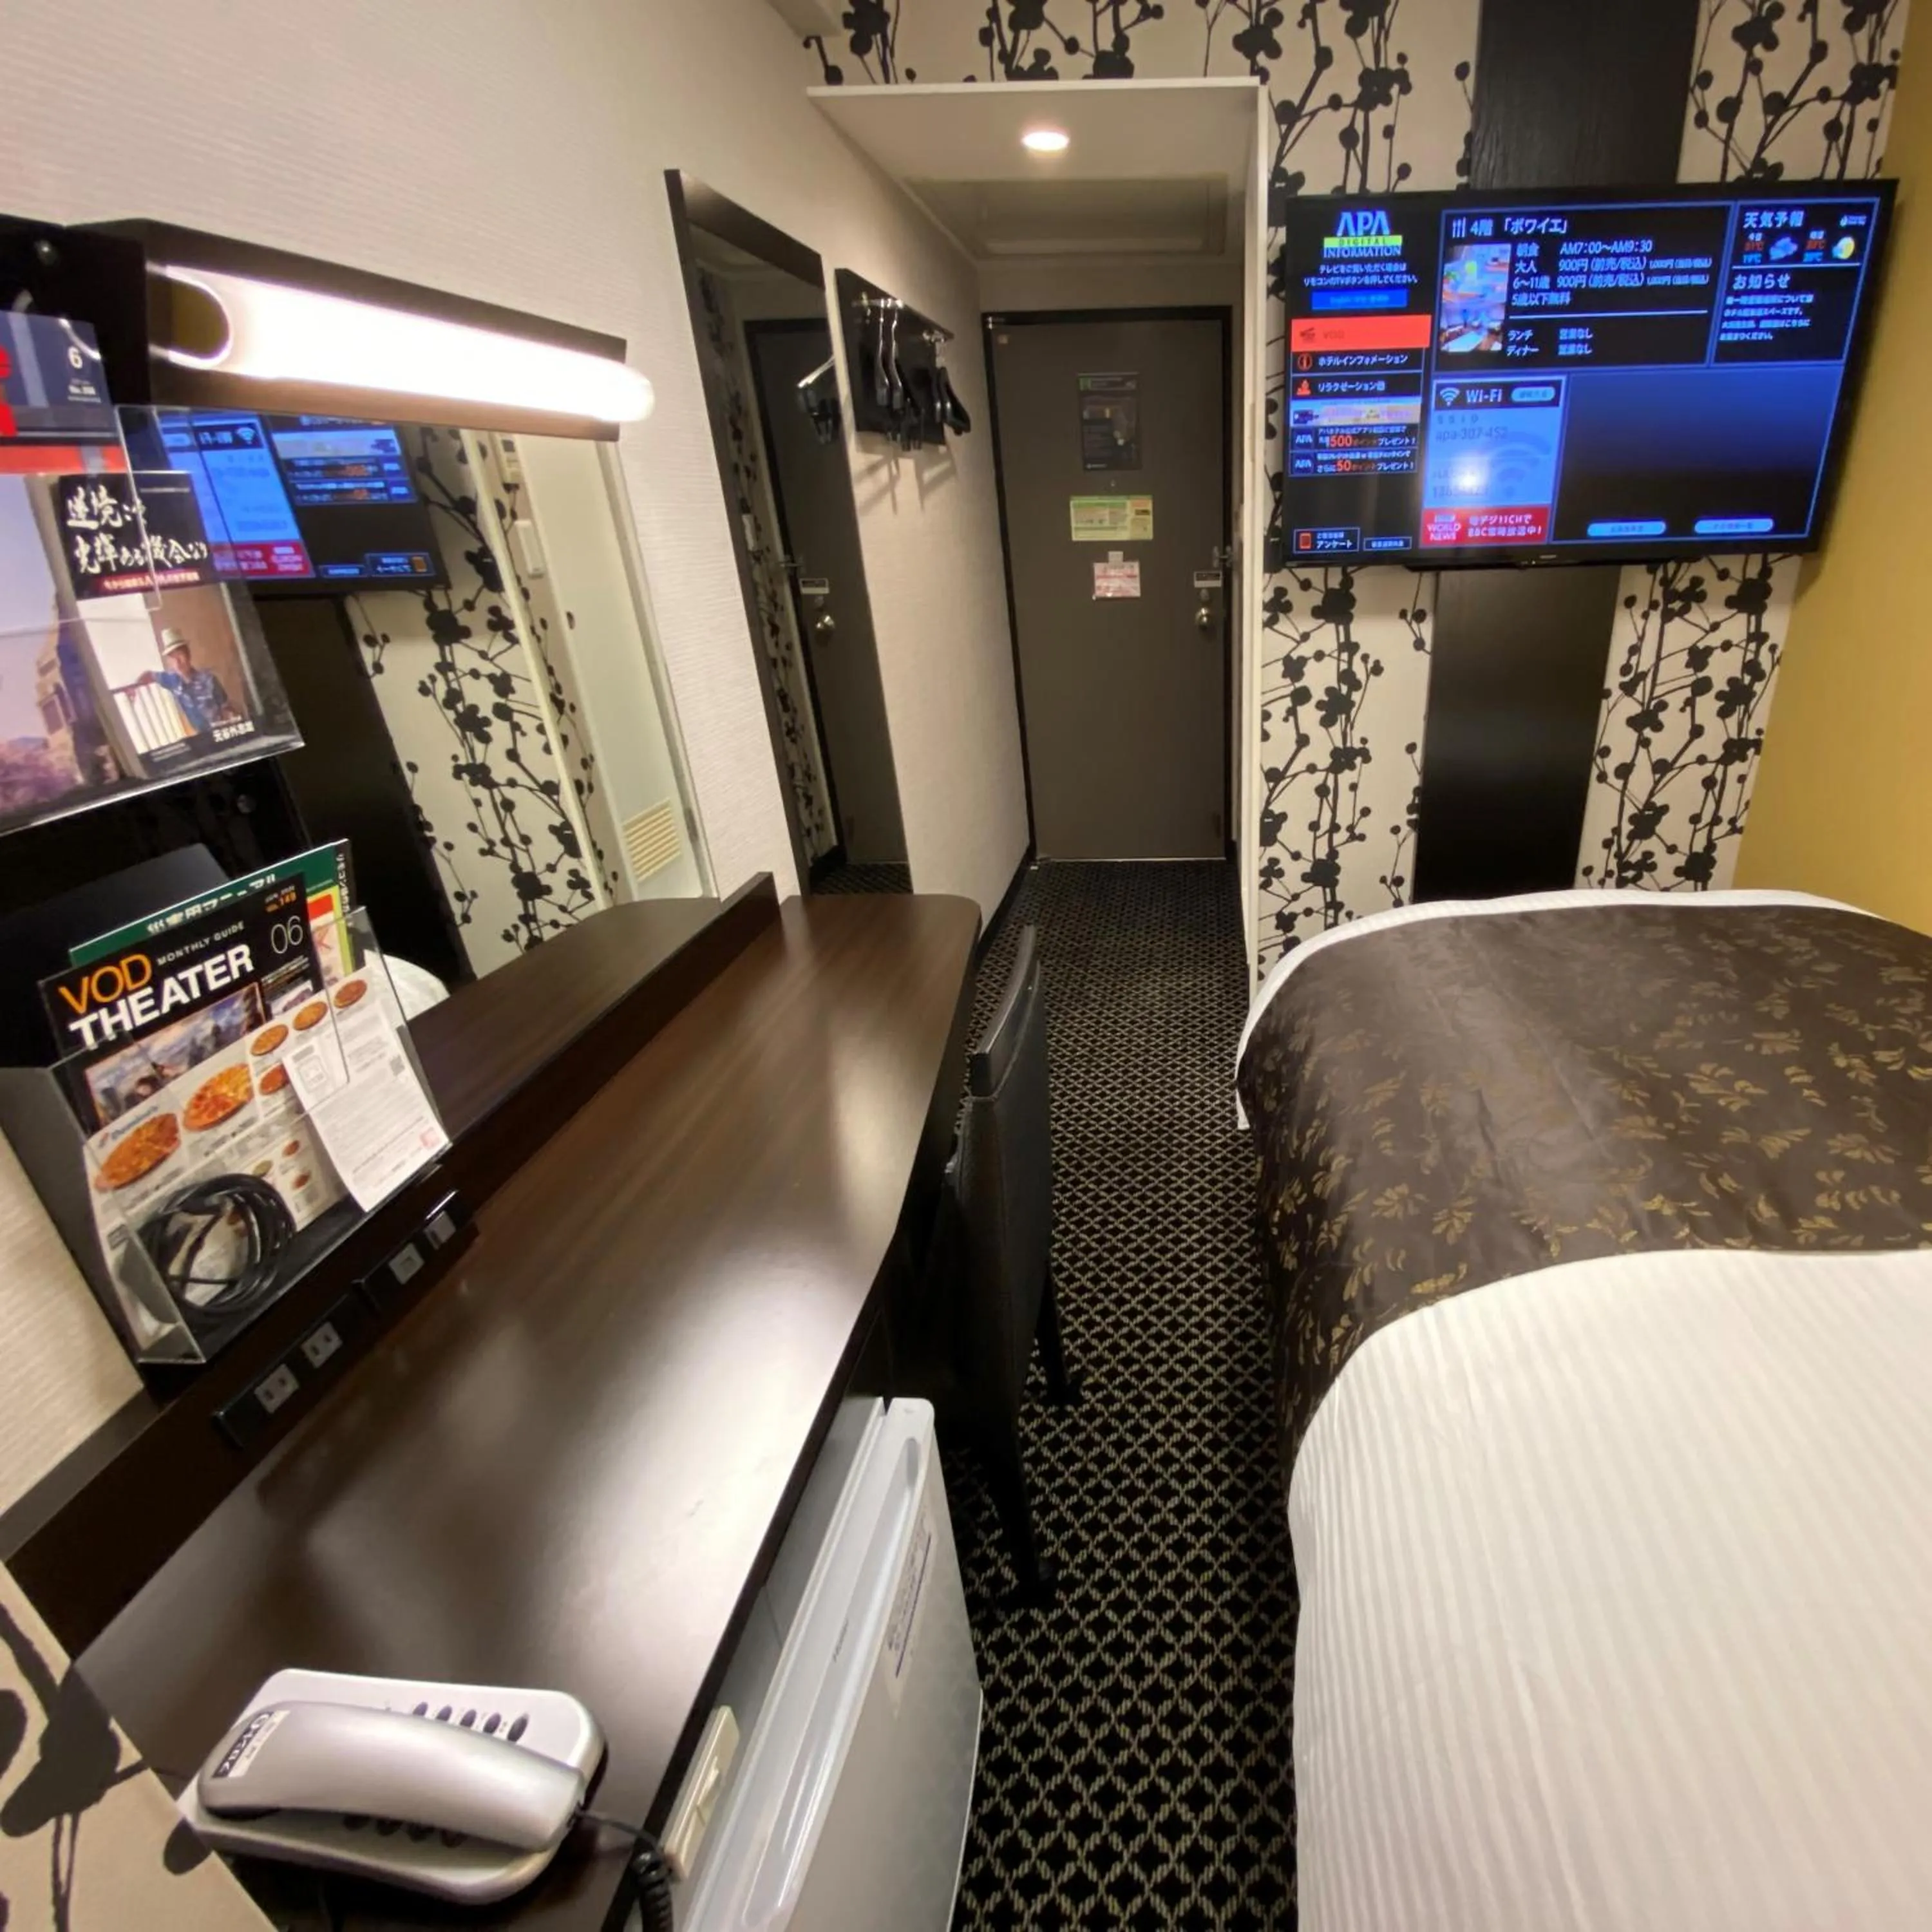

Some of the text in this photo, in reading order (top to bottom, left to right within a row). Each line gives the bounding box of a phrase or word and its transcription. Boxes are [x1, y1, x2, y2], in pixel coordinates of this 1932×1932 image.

[1336, 211, 1391, 236] APA
[1339, 237, 1387, 246] DIGITAL
[1324, 246, 1401, 258] INFORMATION
[1515, 259, 1538, 274] 大人
[1733, 273, 1790, 290] お知らせ
[1508, 328, 1533, 341] ランチ
[68, 346, 83, 369] 6
[1506, 345, 1540, 357] ディナー
[1316, 539, 1352, 549] アンケート
[270, 915, 304, 954] 06
[59, 920, 245, 1015] VOD MONTHLY GUIDE
[68, 943, 255, 1051] THEATER
